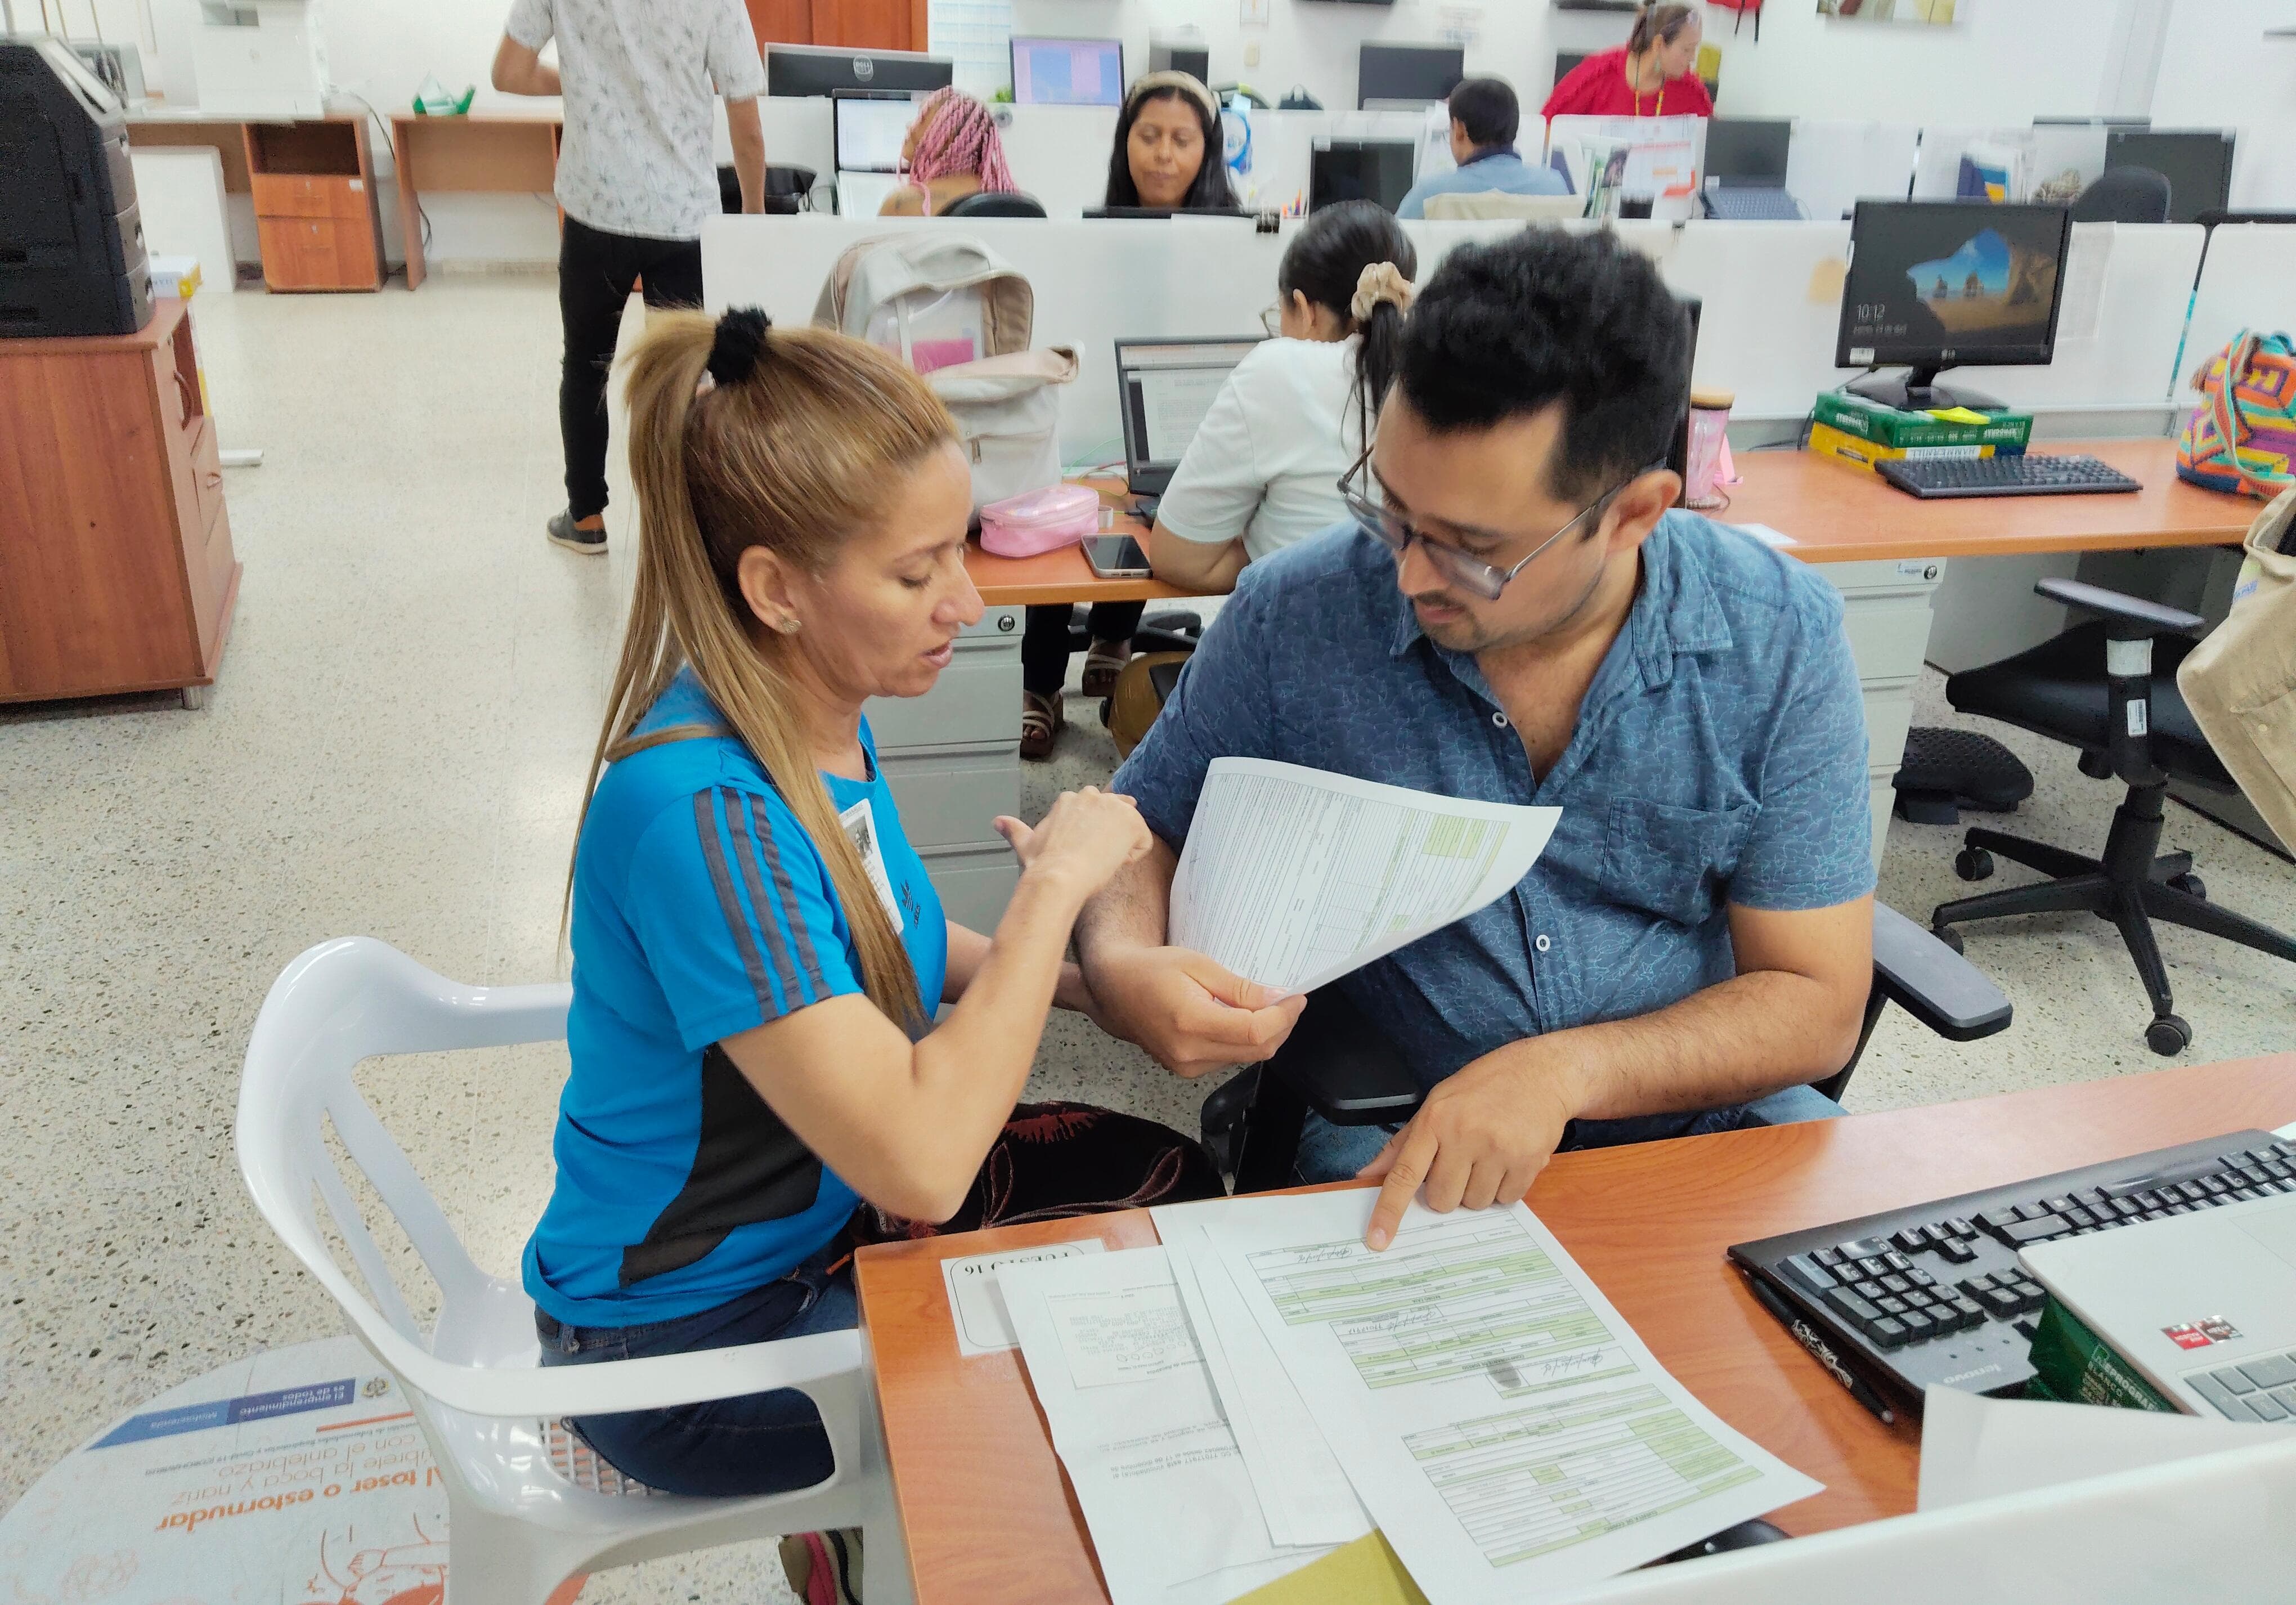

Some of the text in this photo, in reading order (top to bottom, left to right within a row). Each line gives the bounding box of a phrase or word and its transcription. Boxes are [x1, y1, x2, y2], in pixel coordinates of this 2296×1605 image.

[1855, 303, 1886, 321] 10:12
[964, 1264, 983, 1275] 16
[1943, 1364, 2001, 1384] lenovo
[281, 1384, 346, 1402] es de todos
[238, 1392, 344, 1417] El emprendimiento
[346, 1441, 367, 1462] el
[374, 1432, 416, 1452] con
[171, 1448, 432, 1507] úbrete la boca y nariz
[347, 1469, 418, 1498] toser
[321, 1482, 342, 1498] o
[152, 1488, 315, 1533] estornudar
